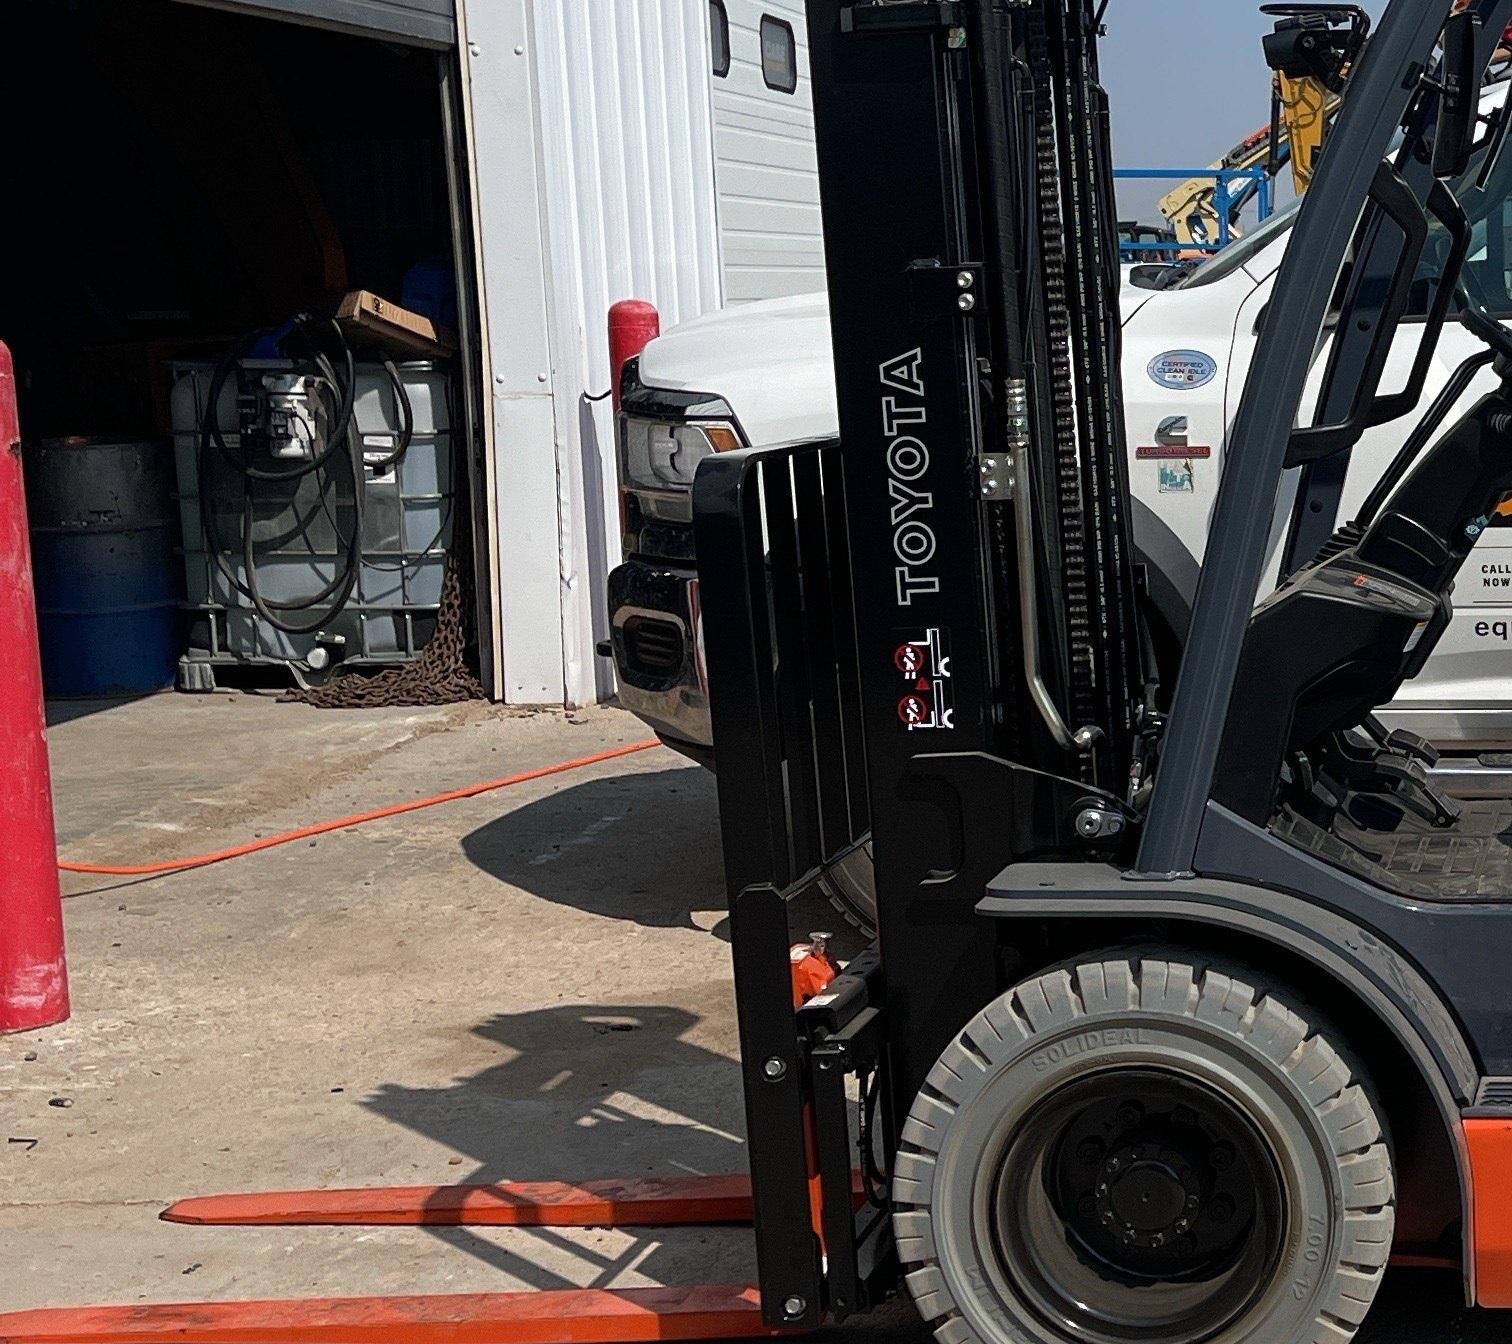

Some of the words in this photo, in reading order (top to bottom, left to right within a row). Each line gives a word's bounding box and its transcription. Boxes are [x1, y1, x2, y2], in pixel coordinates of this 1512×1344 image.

[879, 347, 940, 606] TOYOTA
[1481, 564, 1512, 574] CALL
[1483, 577, 1510, 587] NOW
[1031, 1027, 1150, 1073] SOLIDEAL
